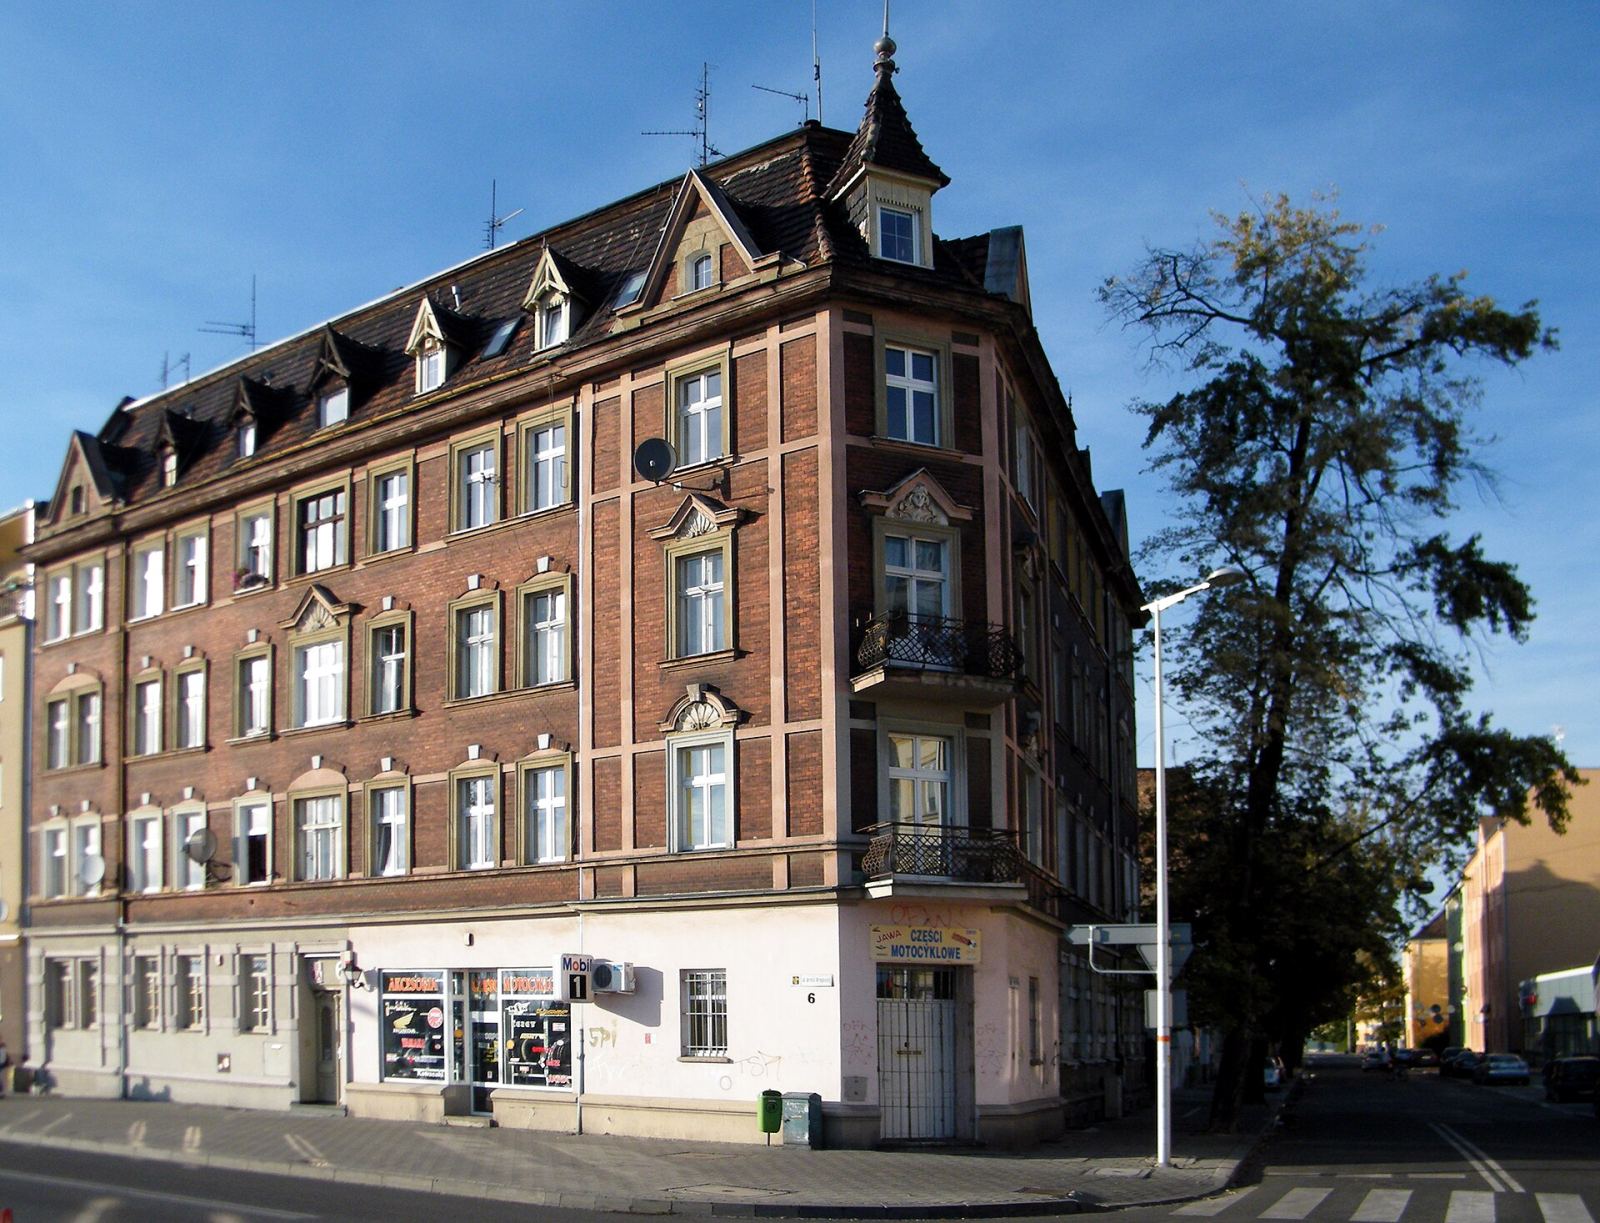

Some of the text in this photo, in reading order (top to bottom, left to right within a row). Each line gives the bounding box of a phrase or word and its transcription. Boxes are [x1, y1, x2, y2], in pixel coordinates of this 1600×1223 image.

[875, 929, 903, 944] JAWA
[891, 945, 961, 960] MOTOCYKLOWE
[562, 957, 593, 972] Mobil
[573, 976, 581, 998] 1
[807, 992, 816, 1004] 6
